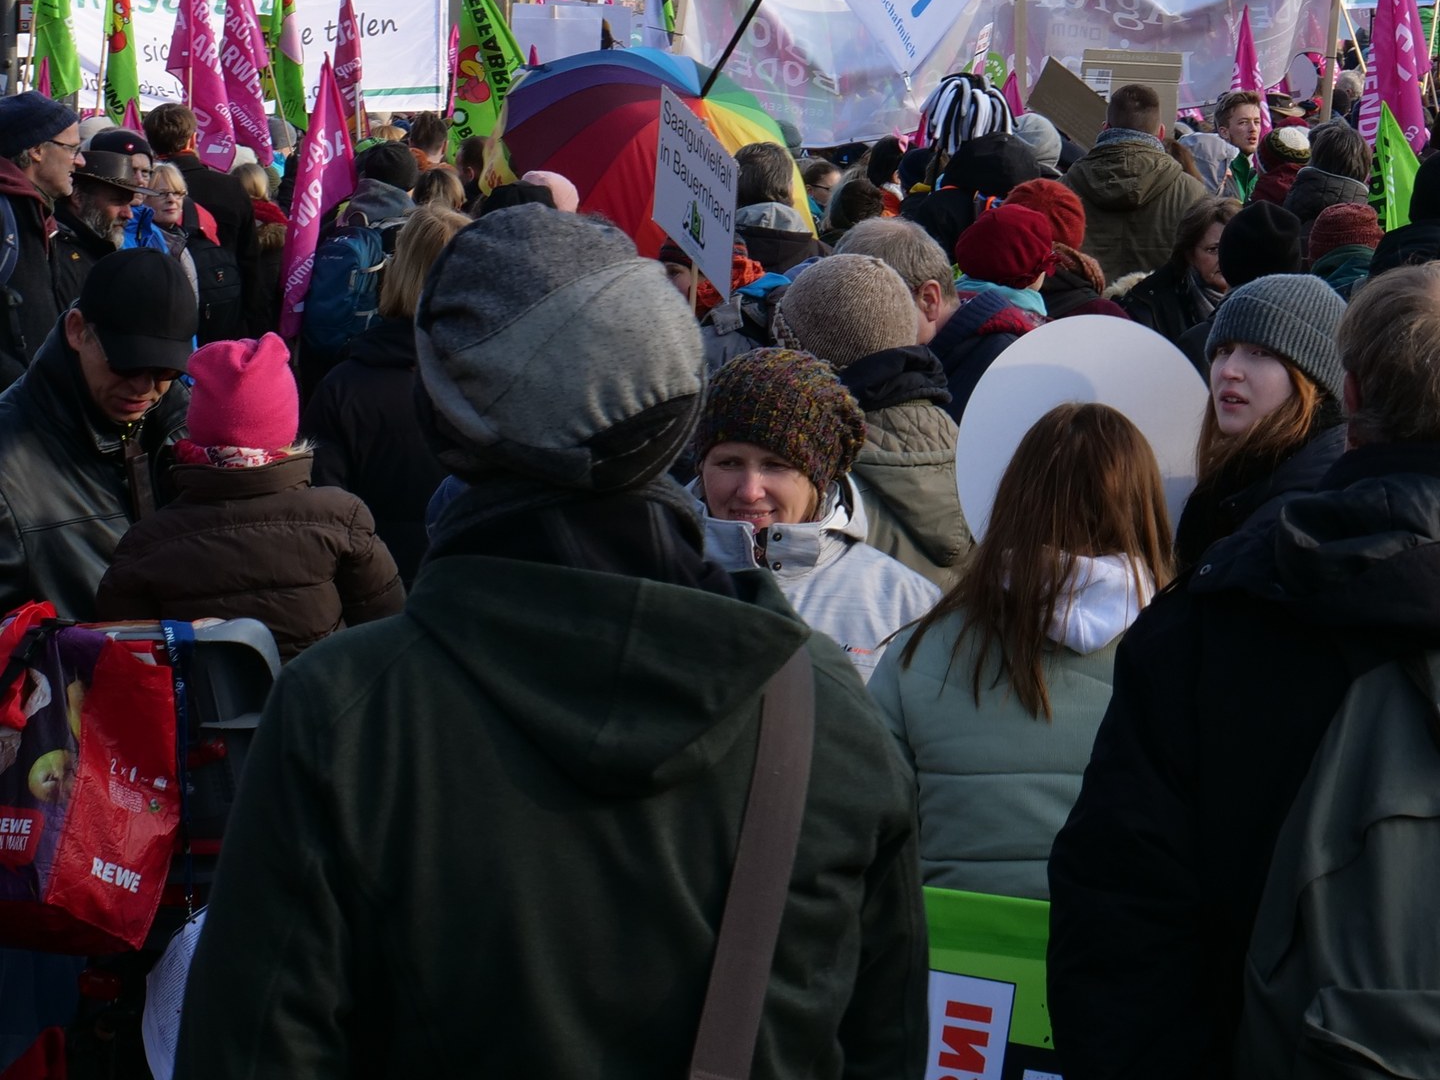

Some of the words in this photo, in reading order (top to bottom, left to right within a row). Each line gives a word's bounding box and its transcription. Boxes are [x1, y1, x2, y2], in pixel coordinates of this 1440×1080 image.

[662, 99, 733, 193] Saatgutvielfalt
[660, 137, 670, 167] in
[672, 149, 732, 234] Bauernhand
[0, 818, 33, 834] EWE
[91, 856, 142, 894] REWE
